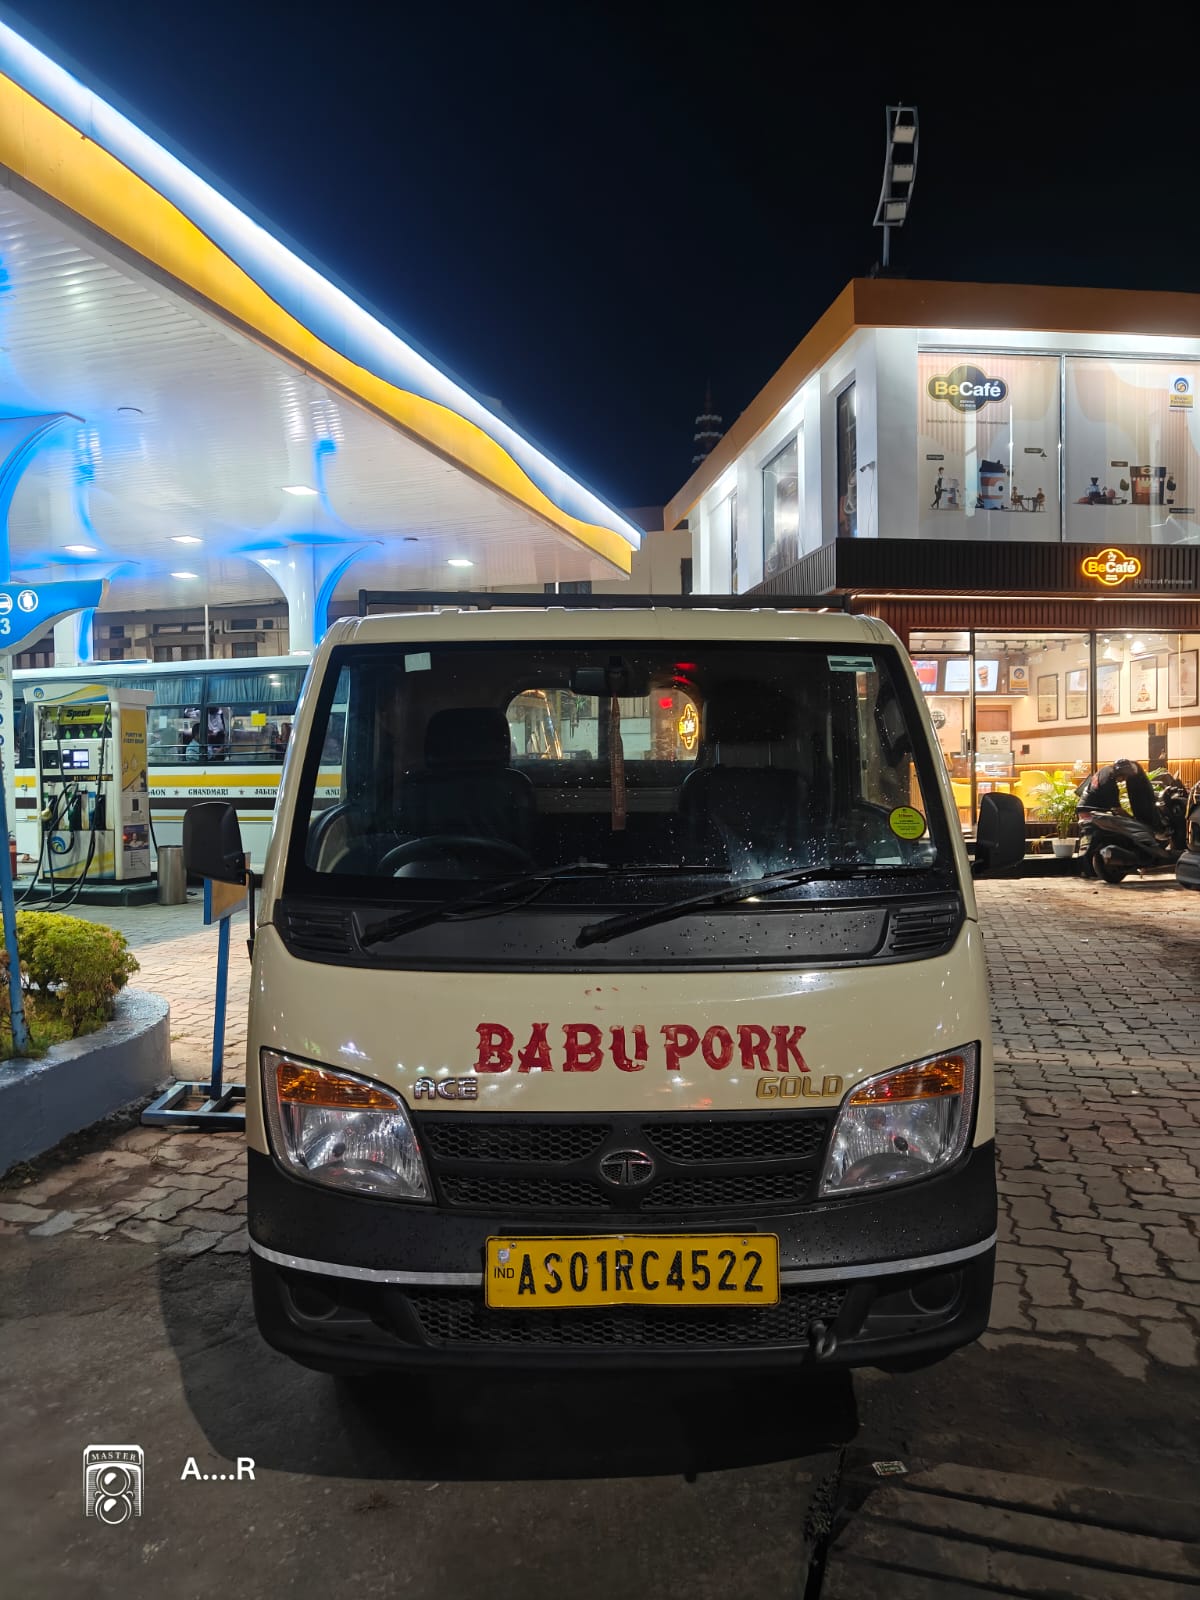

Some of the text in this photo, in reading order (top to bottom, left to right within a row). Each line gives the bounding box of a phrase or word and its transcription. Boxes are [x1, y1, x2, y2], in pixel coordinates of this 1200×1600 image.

[935, 381, 1001, 397] BeCafé
[1088, 561, 1136, 573] BeCafé
[66, 709, 92, 720] Speed
[148, 788, 166, 796] AON
[254, 788, 278, 796] JALUK
[474, 1023, 811, 1073] BABU PORK
[414, 1077, 479, 1100] ACE
[756, 1075, 843, 1099] GOLD
[494, 1267, 515, 1279] IND
[518, 1250, 764, 1295] AS01RC4522
